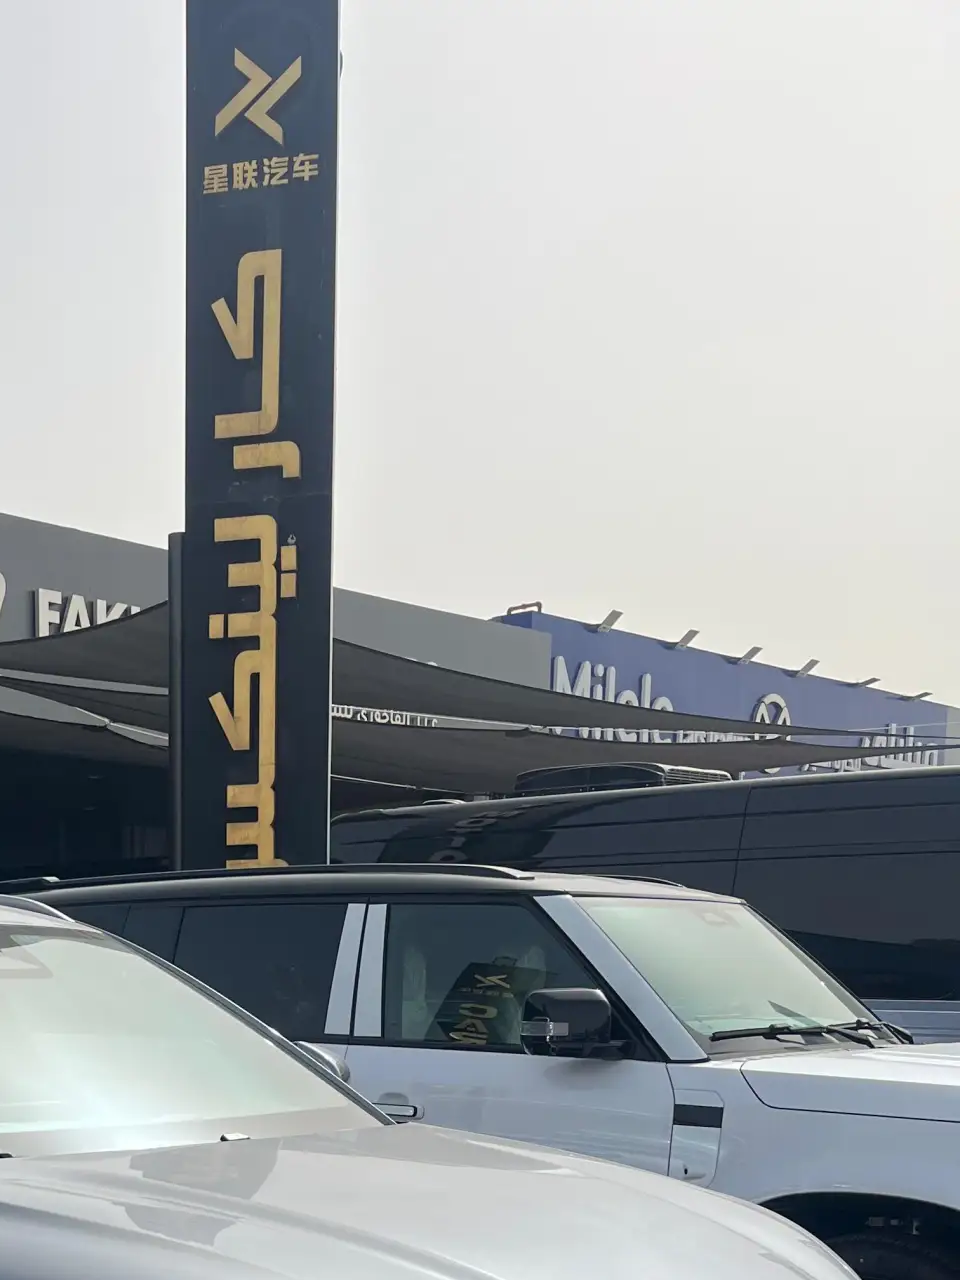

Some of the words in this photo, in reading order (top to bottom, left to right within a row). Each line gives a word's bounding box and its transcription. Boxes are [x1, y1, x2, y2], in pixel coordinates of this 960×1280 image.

[203, 152, 320, 194] 星联汽车
[211, 248, 300, 478] كار
[37, 587, 141, 638] FAK
